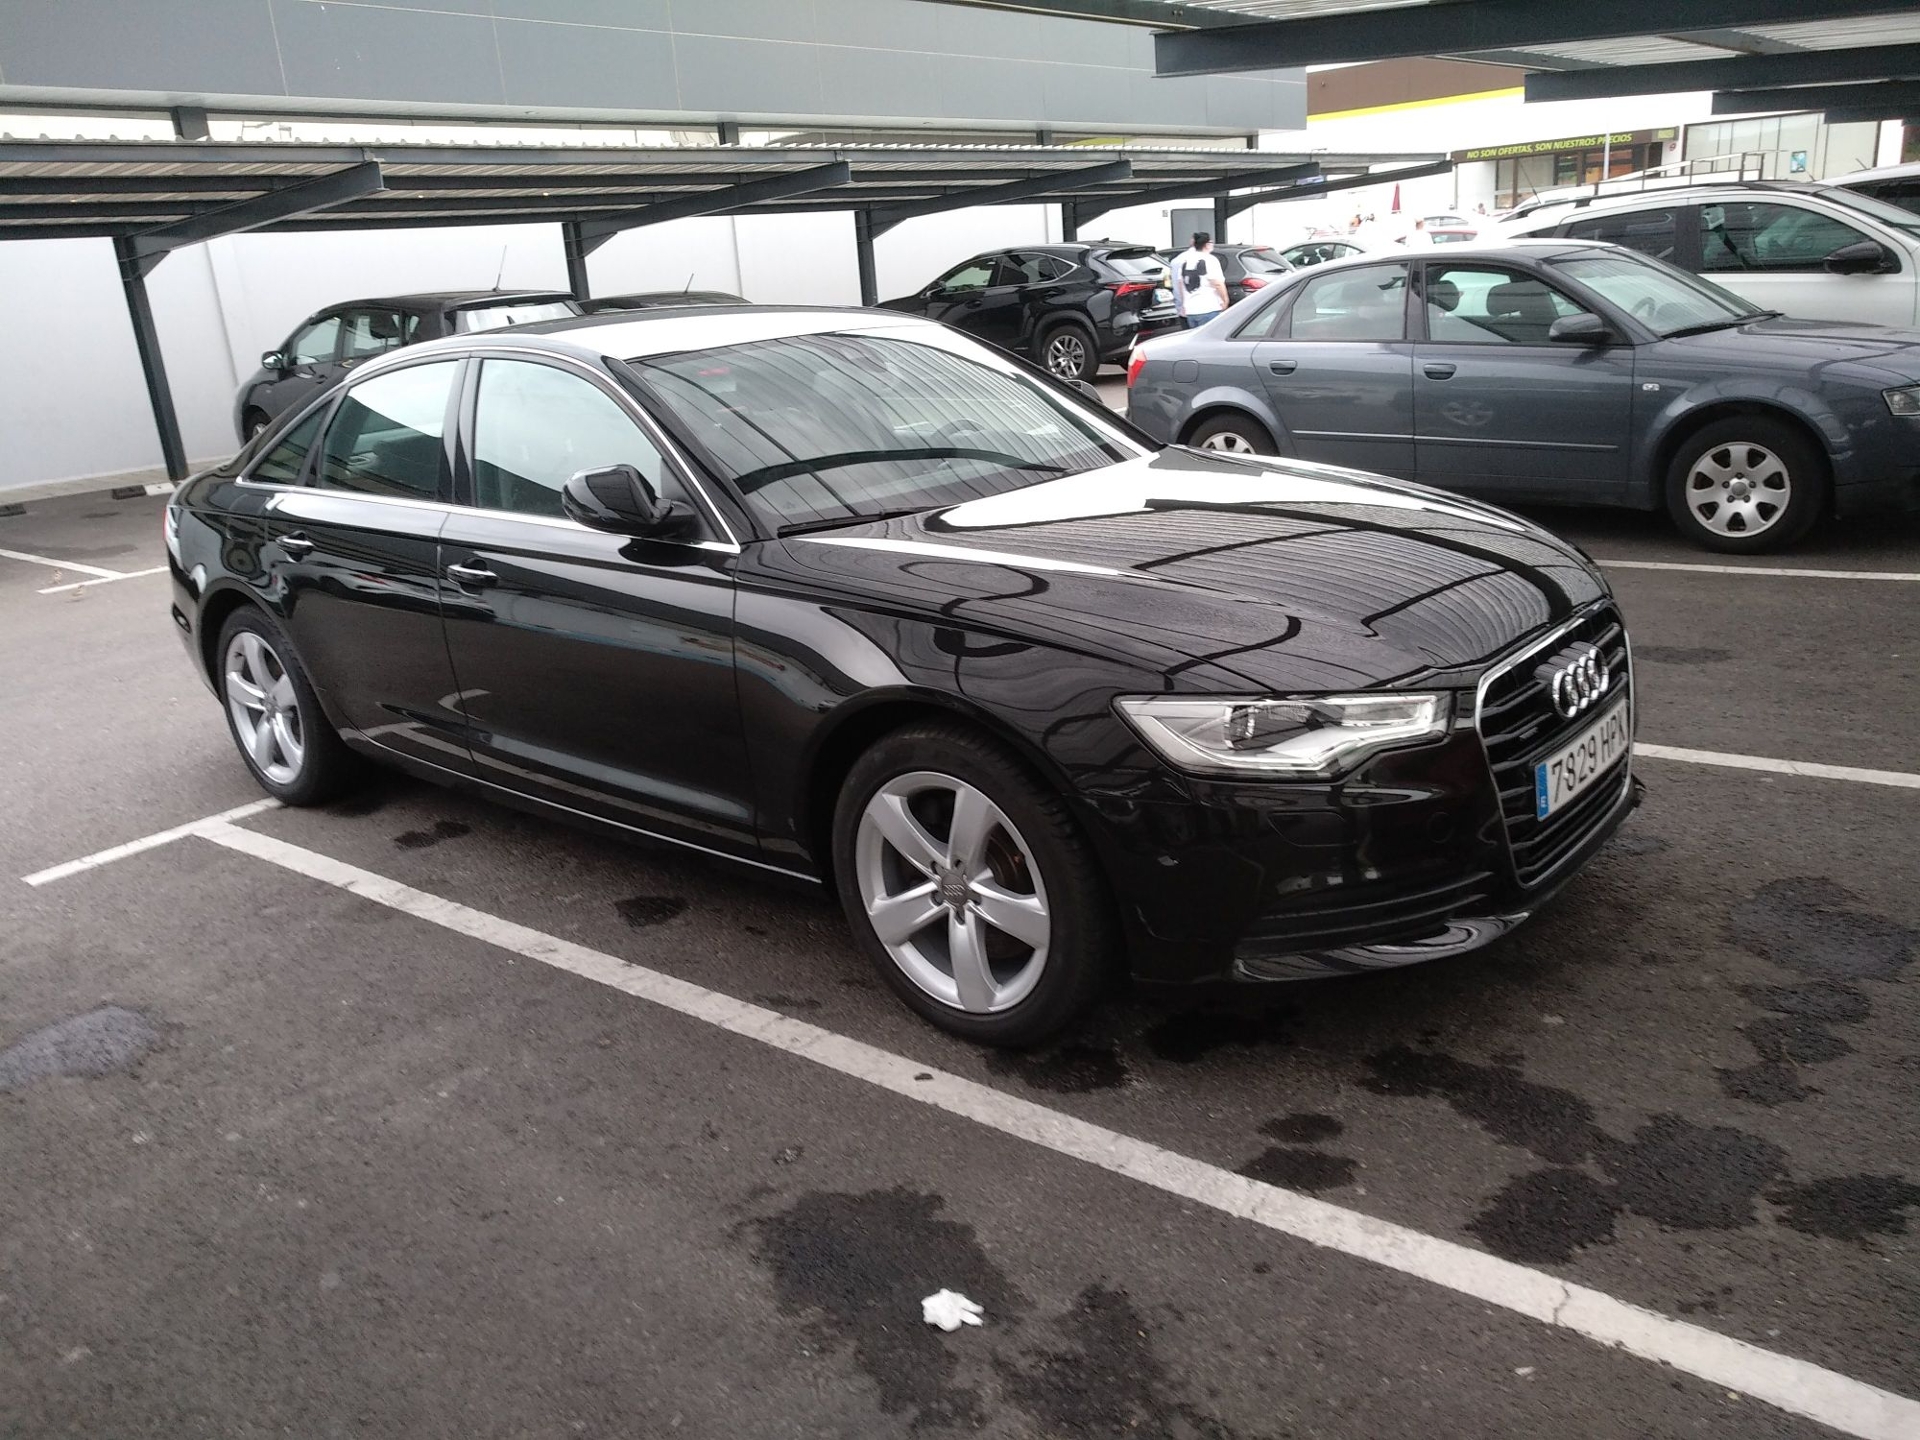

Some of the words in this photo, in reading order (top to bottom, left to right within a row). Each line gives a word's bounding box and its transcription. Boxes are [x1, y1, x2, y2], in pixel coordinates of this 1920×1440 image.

[1466, 151, 1479, 159] NO
[1480, 148, 1497, 158] SON
[1498, 144, 1533, 155] OFERTAS,
[1535, 141, 1553, 152] SON
[1553, 137, 1596, 150] NUESTROS
[1551, 735, 1597, 803] 7829
